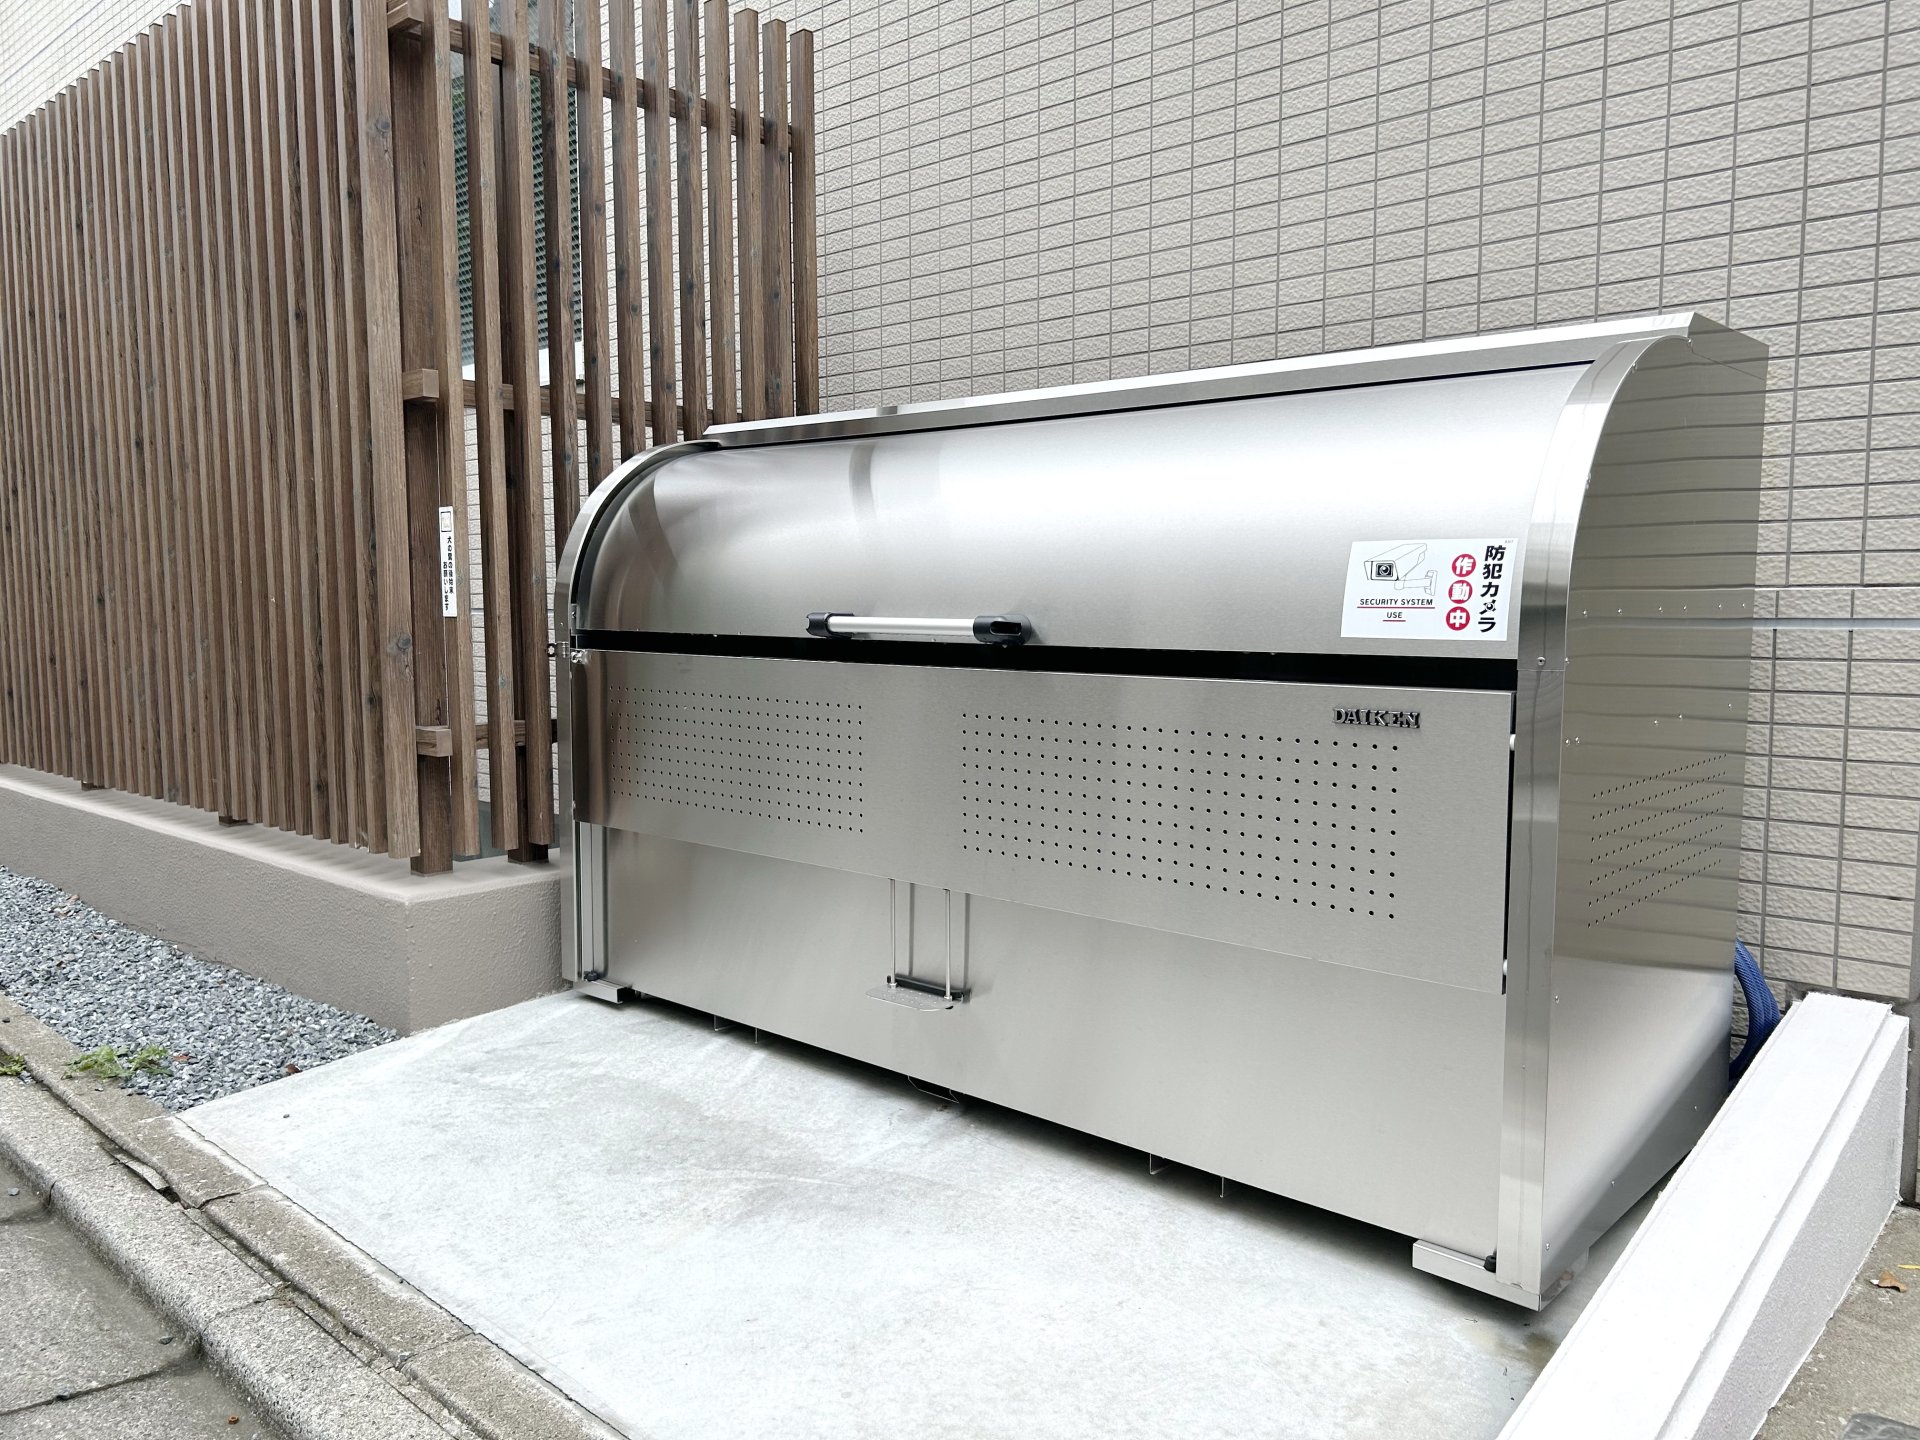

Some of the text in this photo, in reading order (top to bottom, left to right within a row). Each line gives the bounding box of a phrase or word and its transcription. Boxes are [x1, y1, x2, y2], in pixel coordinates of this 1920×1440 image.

[1449, 556, 1474, 628] 作動中
[1478, 545, 1506, 633] 防犯カメラ
[1360, 598, 1433, 606] SECURITY SYSTEM
[1386, 611, 1403, 619] USE
[1333, 707, 1420, 729] DAIKEN
